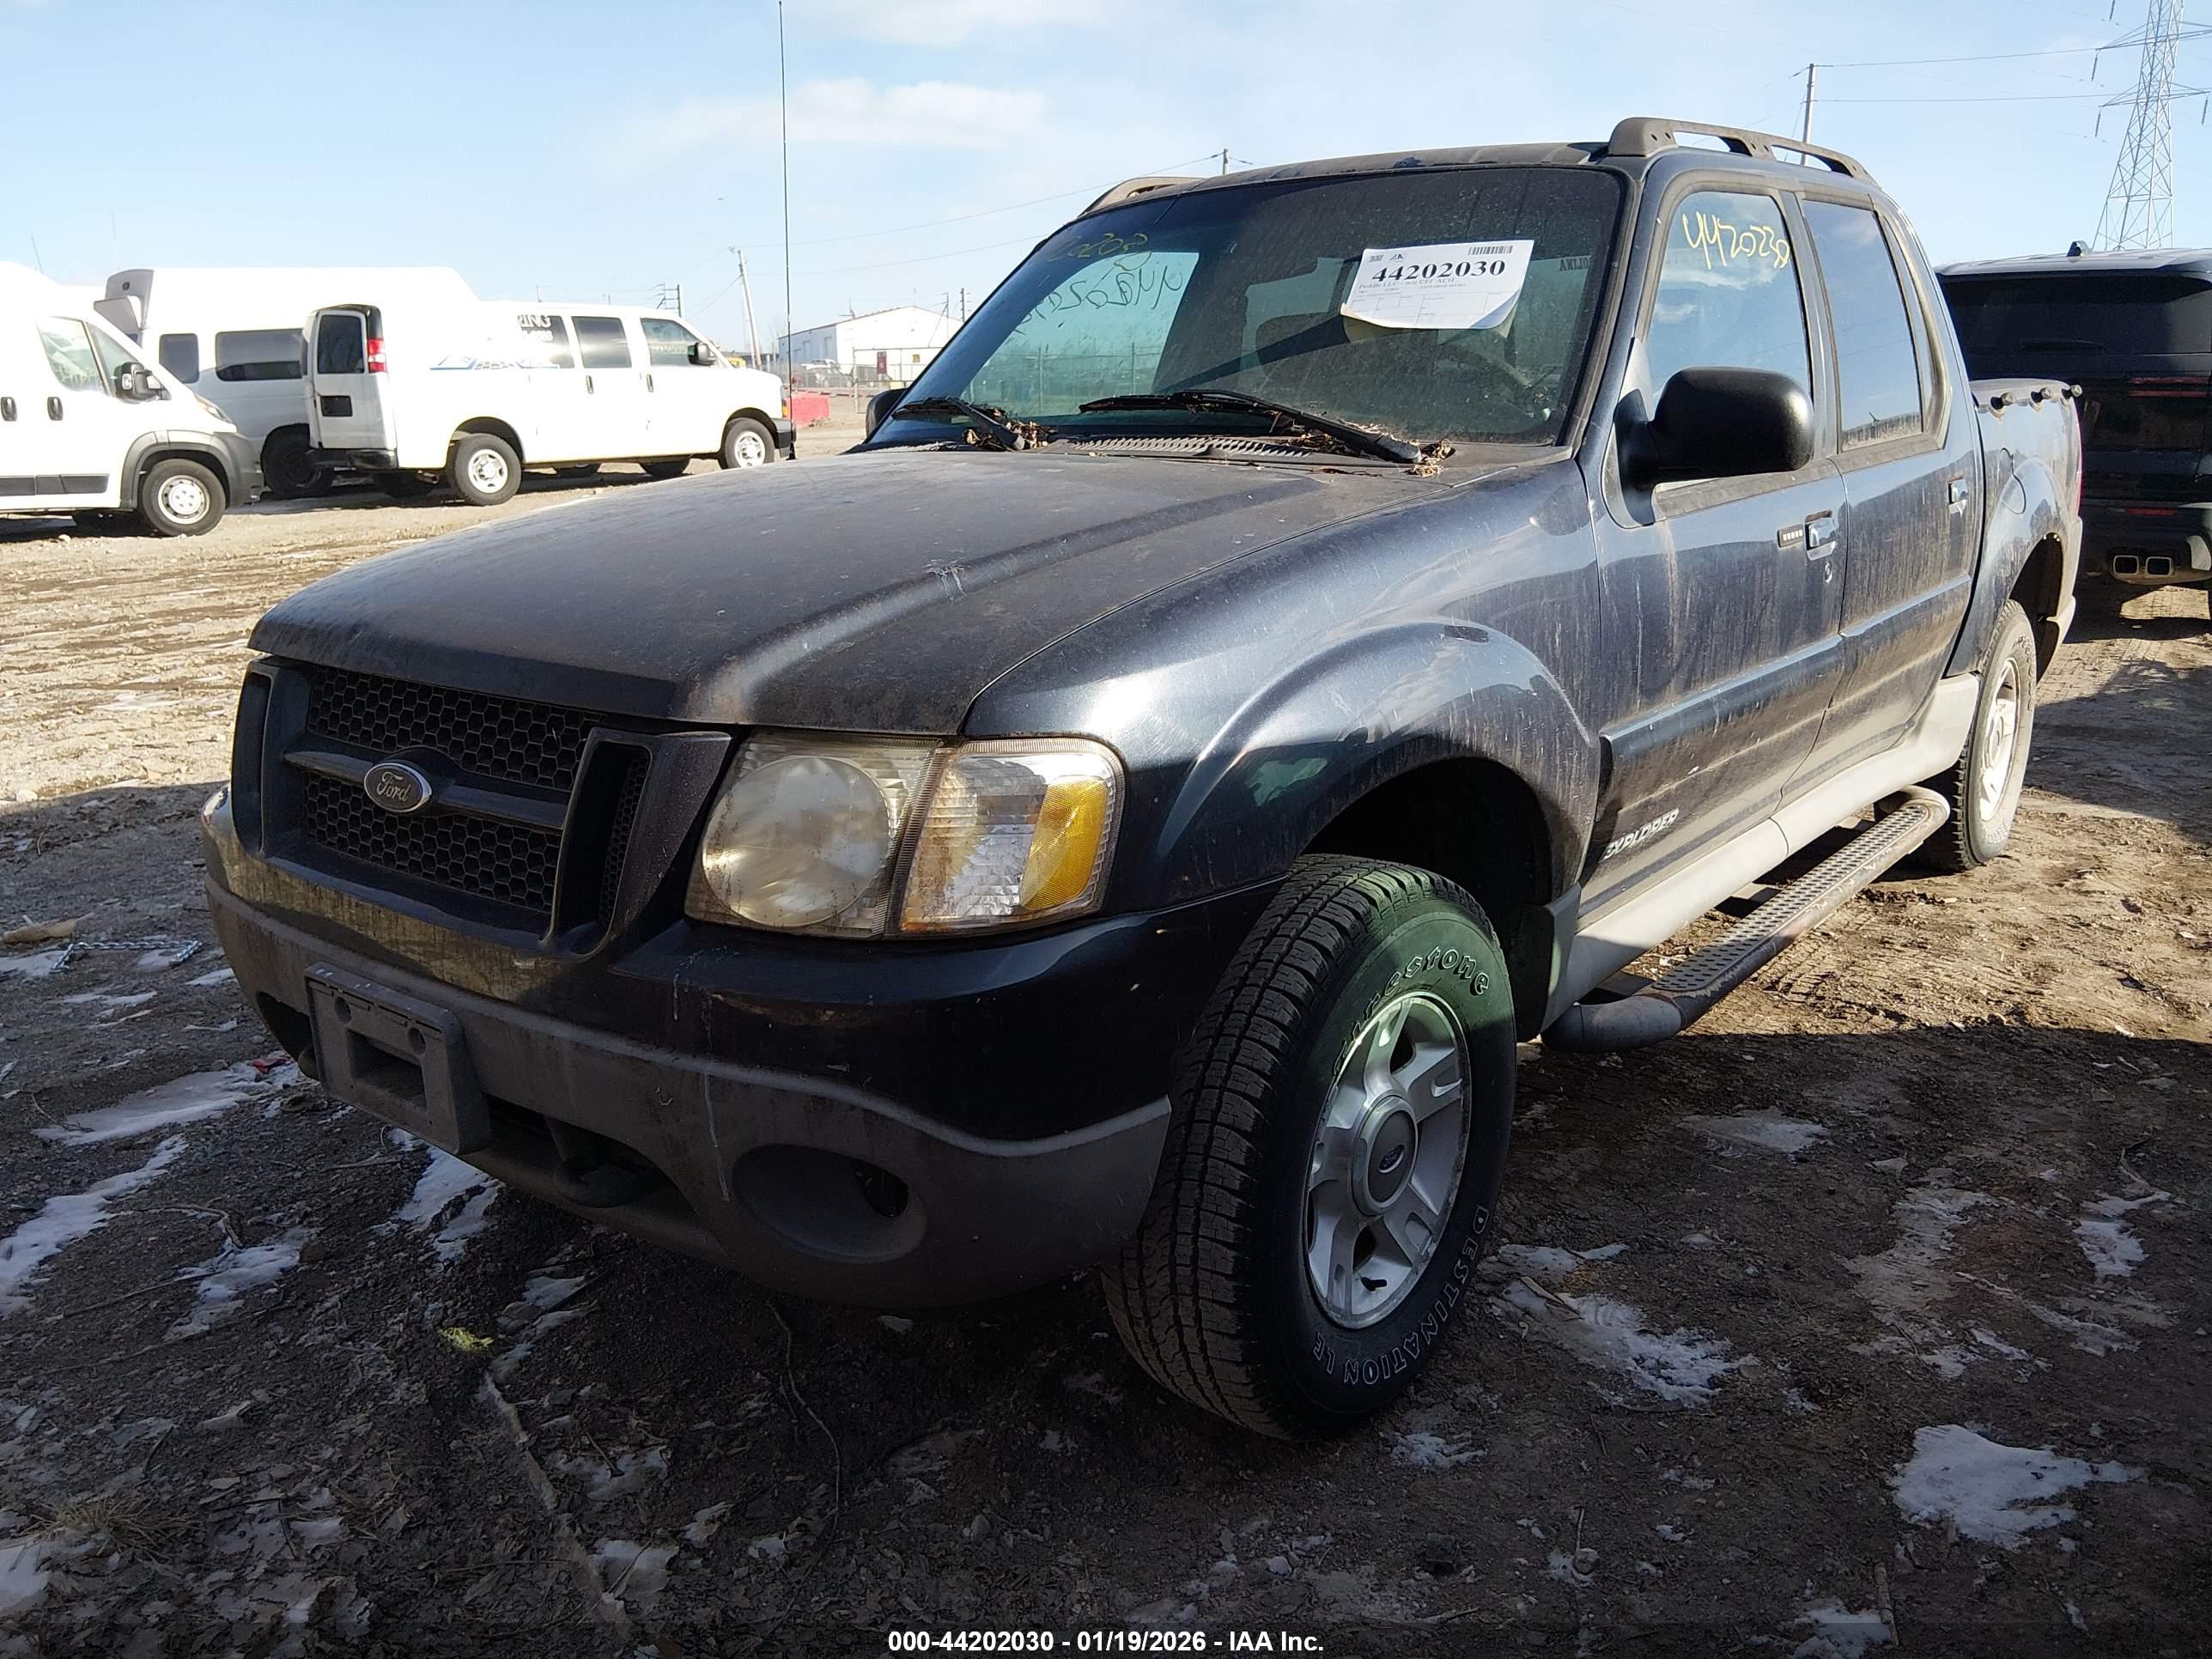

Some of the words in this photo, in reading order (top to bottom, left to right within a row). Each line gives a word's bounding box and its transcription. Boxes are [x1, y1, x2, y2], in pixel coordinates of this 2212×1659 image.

[1372, 260, 1505, 282] 44202030
[376, 770, 412, 802] Ford
[1601, 807, 1680, 861] EXPLORER
[1343, 1206, 1490, 1386] DESTINATION
